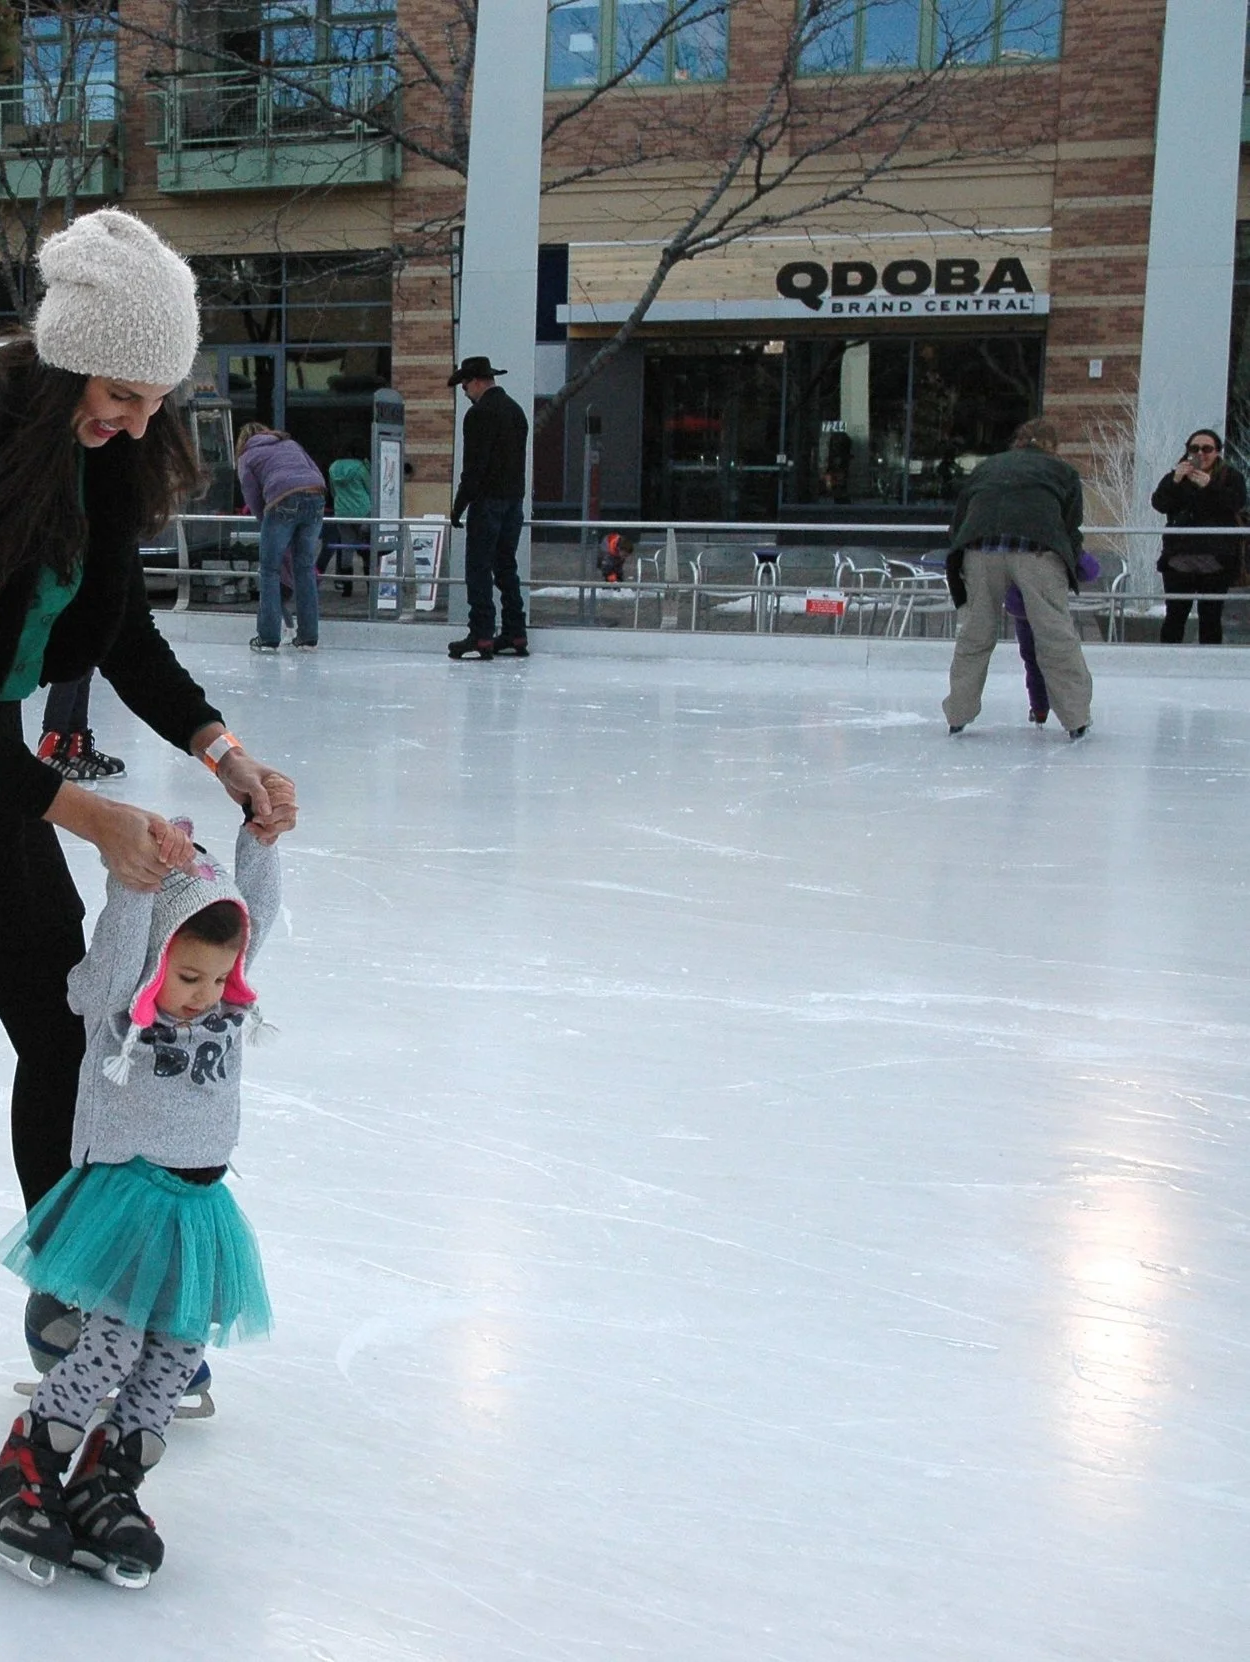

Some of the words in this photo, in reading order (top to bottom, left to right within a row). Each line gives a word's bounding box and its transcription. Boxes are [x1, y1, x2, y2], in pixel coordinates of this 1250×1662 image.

[776, 257, 1034, 311] QDOBA
[831, 301, 912, 314] BRAND
[924, 299, 1031, 313] CENTRAL
